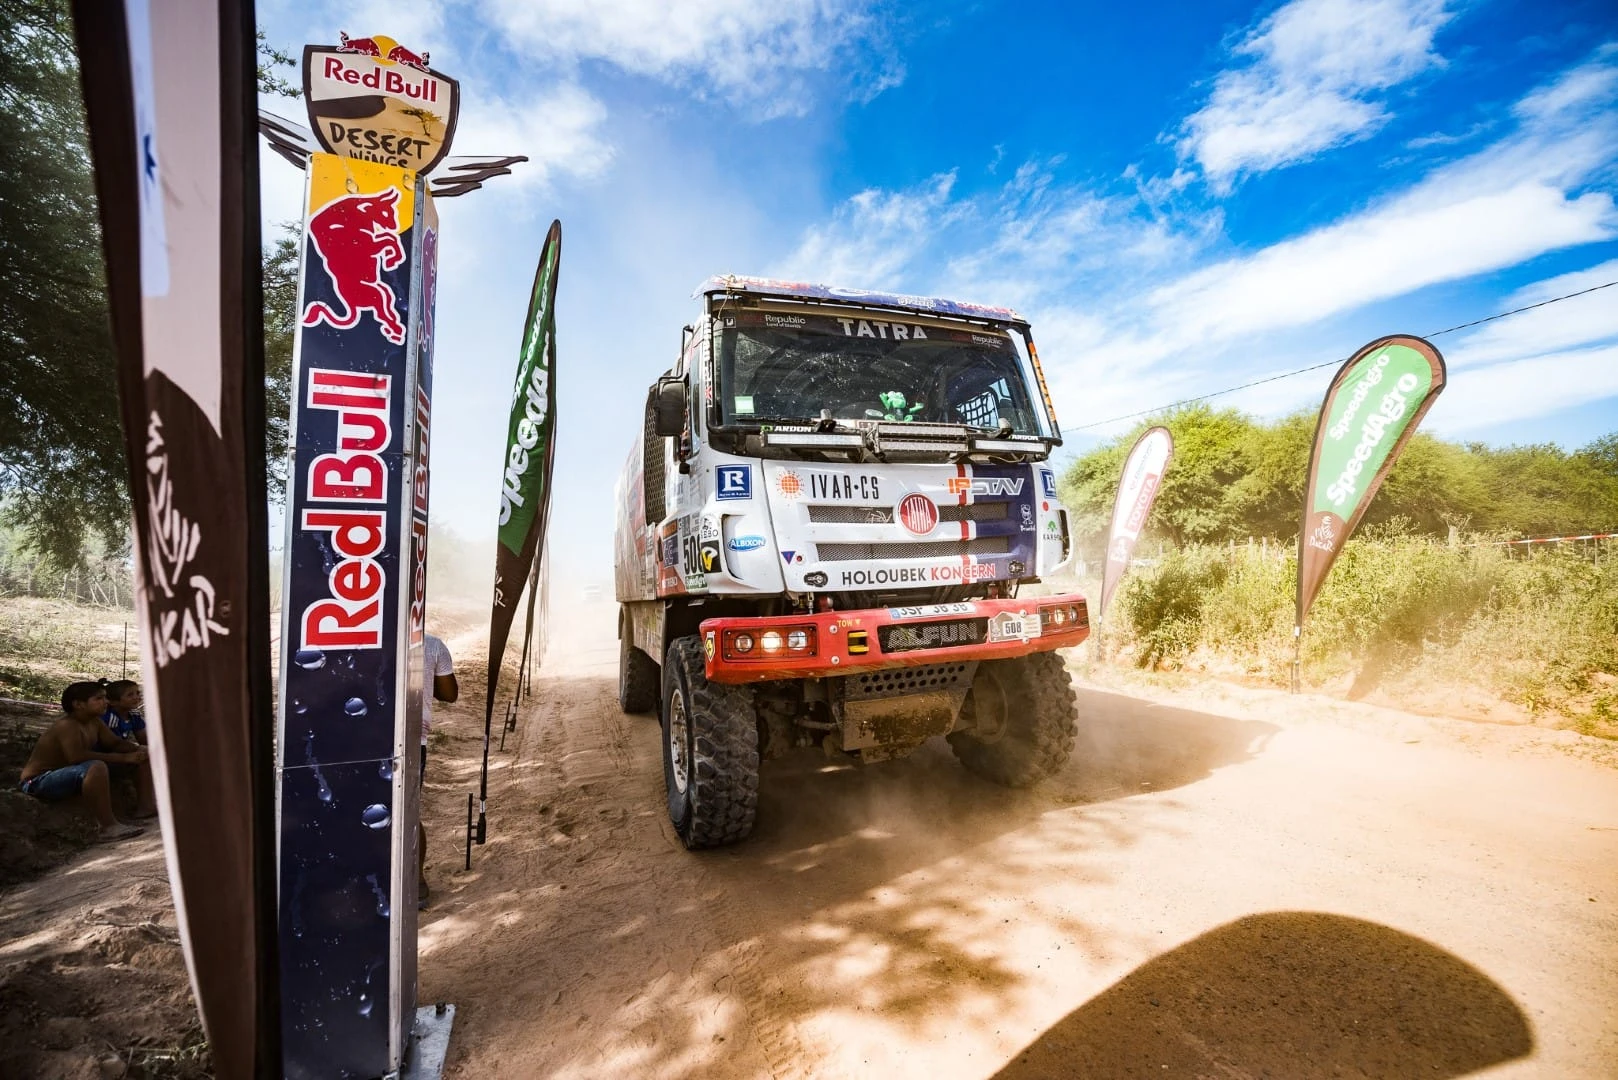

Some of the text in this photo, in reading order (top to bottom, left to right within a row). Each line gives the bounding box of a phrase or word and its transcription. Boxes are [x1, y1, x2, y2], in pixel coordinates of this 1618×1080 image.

[324, 57, 438, 103] Red Bull
[329, 122, 430, 159] DESERT
[765, 315, 807, 326] Republic
[837, 317, 928, 340] TATRA
[1329, 354, 1390, 440] SpeedAgro
[1326, 373, 1418, 506] SpeedAgro
[302, 368, 391, 650] Red Bull
[409, 384, 429, 648] Red Bull
[1128, 478, 1157, 529] TOYOTA
[729, 537, 765, 548] ALBIXON
[842, 563, 996, 585] HOLOUBEK KONCERN
[837, 620, 853, 628] TOW
[1005, 622, 1022, 634] 508
